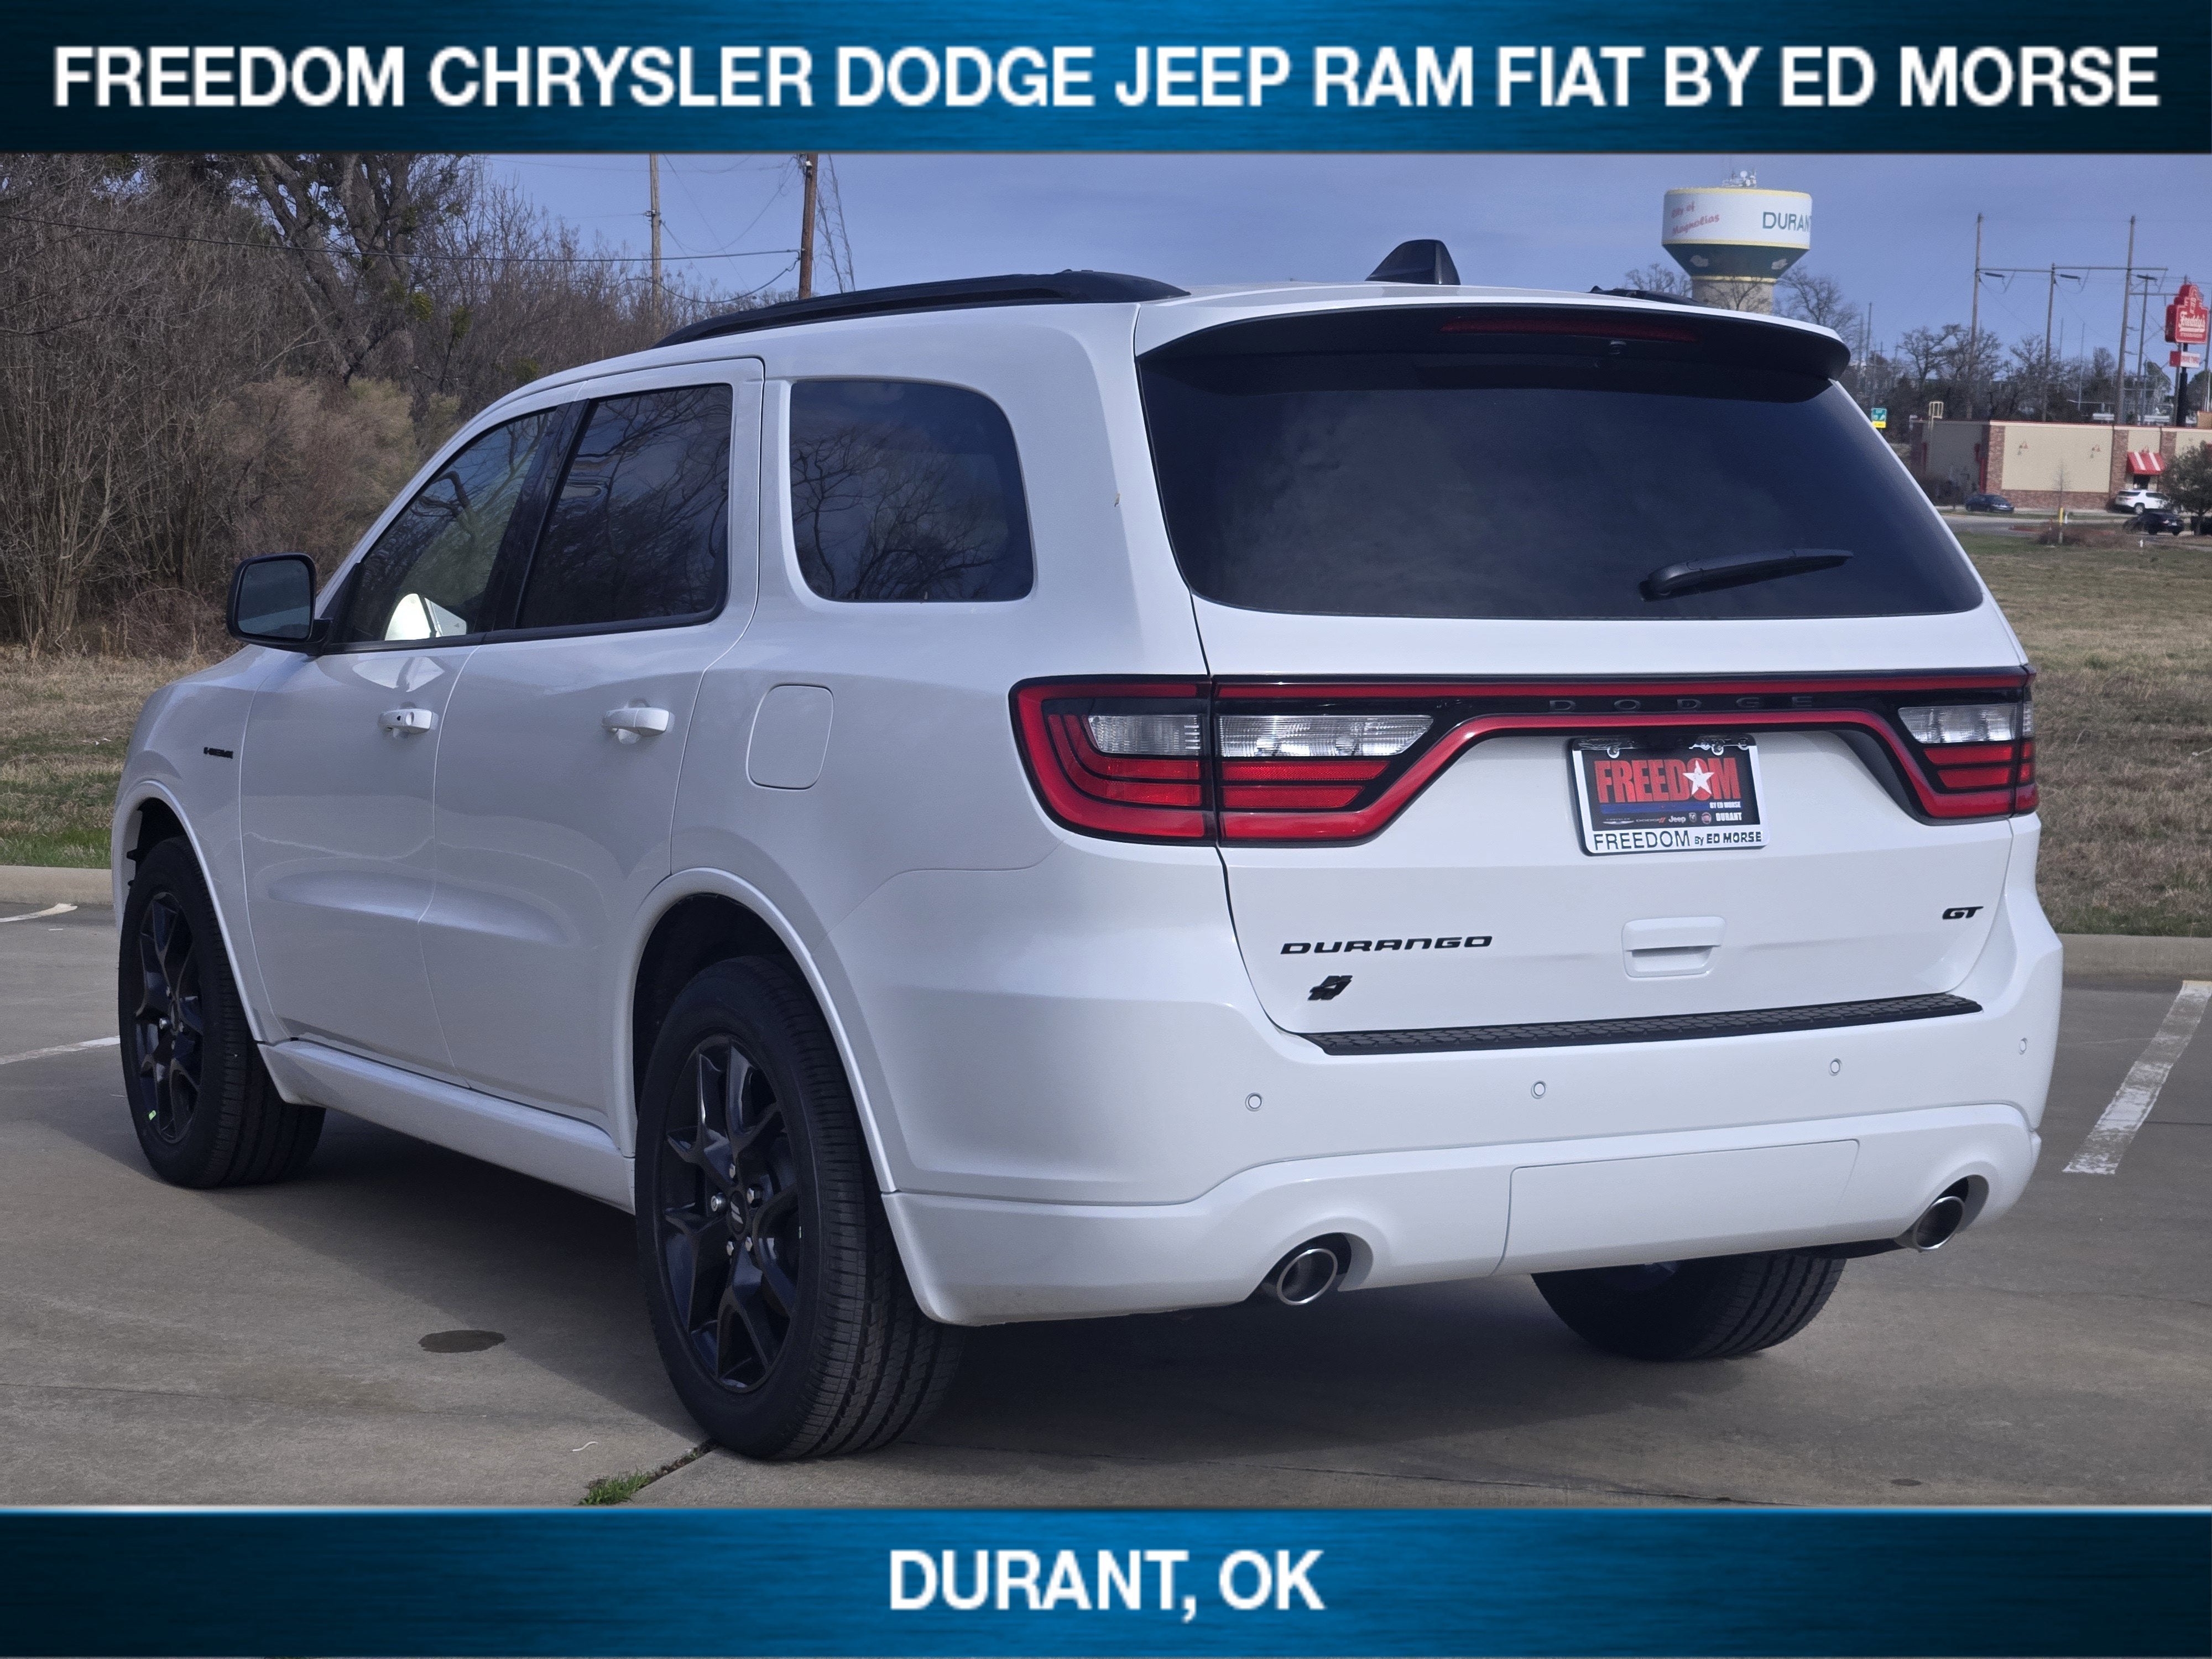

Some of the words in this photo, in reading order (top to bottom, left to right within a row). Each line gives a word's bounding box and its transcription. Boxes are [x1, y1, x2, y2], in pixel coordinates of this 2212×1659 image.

[1549, 696, 1813, 712] DODGE
[1594, 758, 1741, 803] FREEDOM
[1668, 816, 1686, 824] Jeep
[1715, 812, 1742, 822] DURANT
[1594, 830, 1691, 851] FREEDOM
[1707, 833, 1720, 844] ED
[1723, 831, 1762, 844] MORSE
[1942, 906, 1984, 920] GT
[1280, 936, 1493, 954] DURANGO
